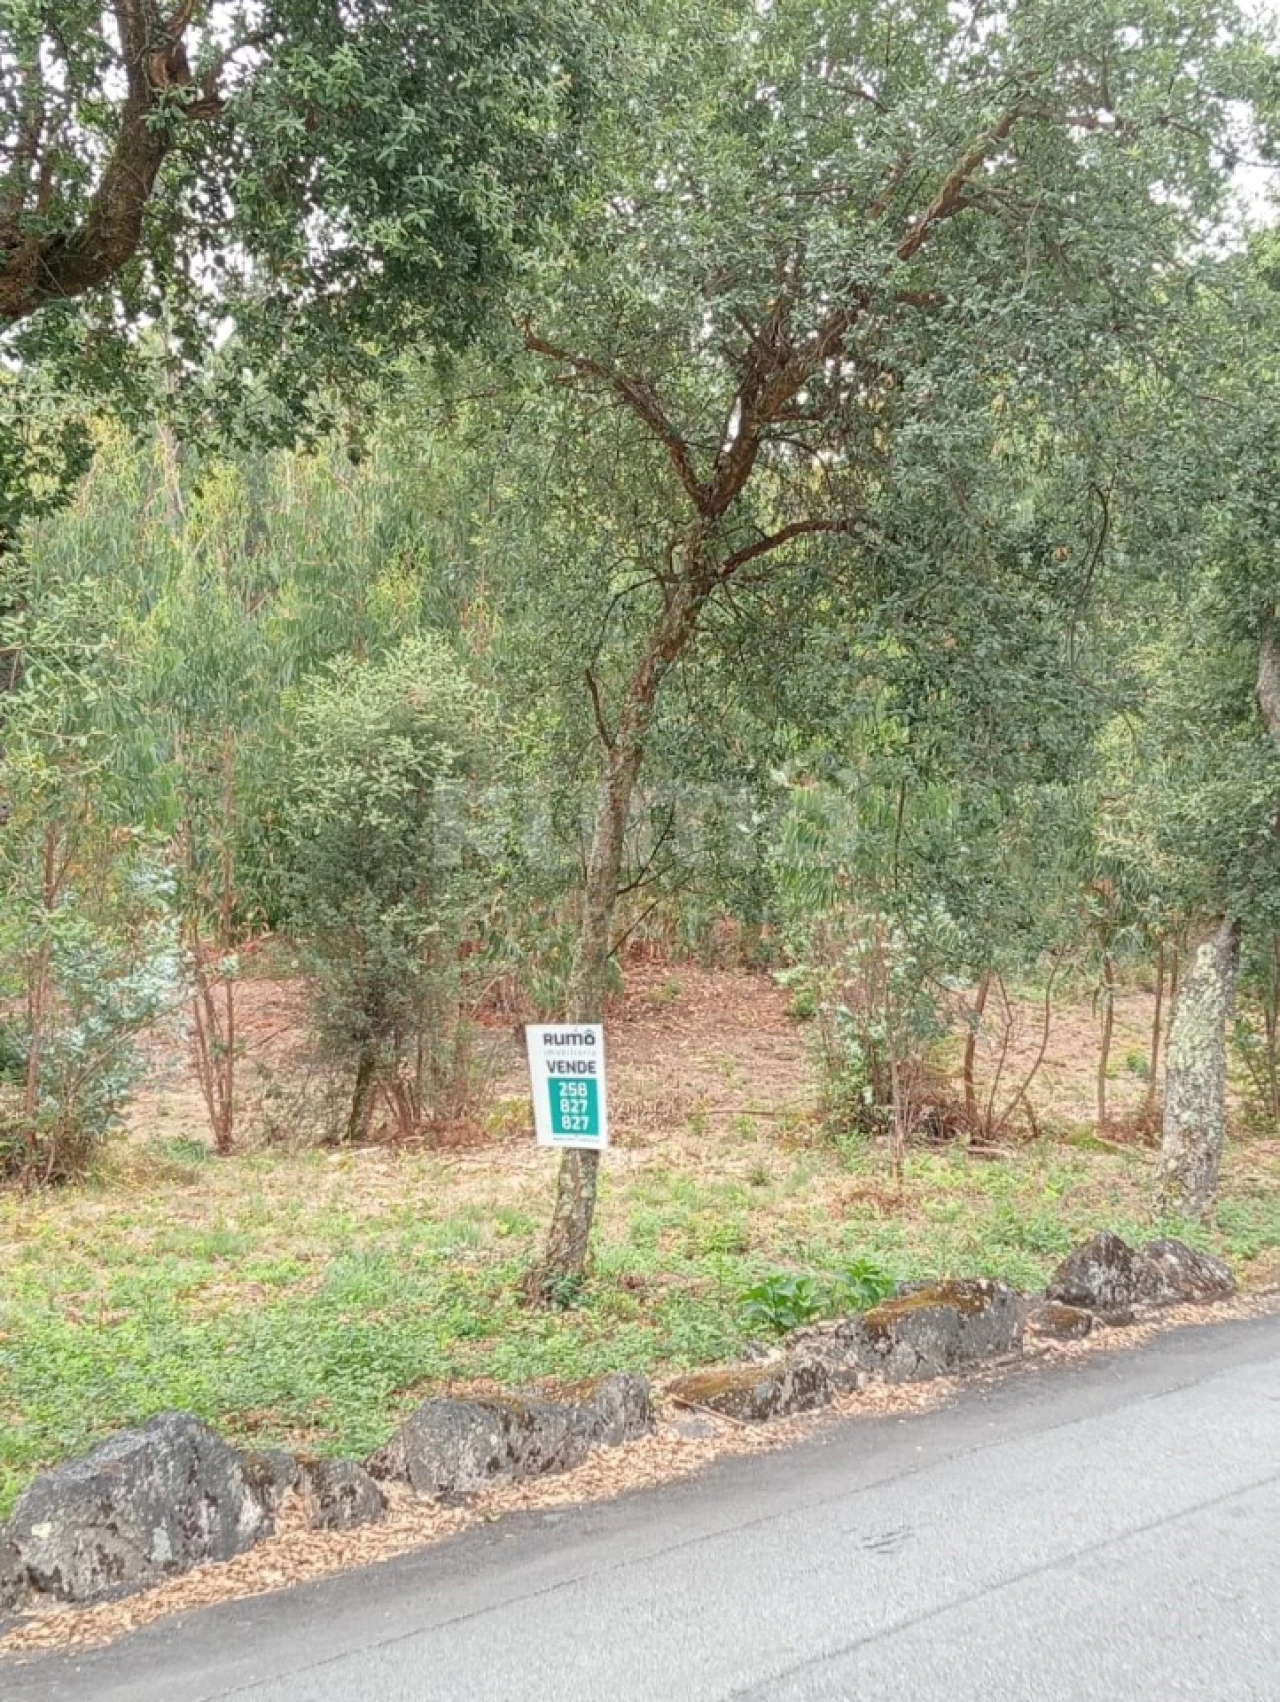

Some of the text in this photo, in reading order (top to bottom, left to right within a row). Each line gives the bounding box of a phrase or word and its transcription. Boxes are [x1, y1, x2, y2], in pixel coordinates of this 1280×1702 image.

[546, 1060, 597, 1074] VENDE
[558, 1081, 587, 1097] 258
[560, 1098, 588, 1114] 827
[561, 1114, 590, 1130] 827
